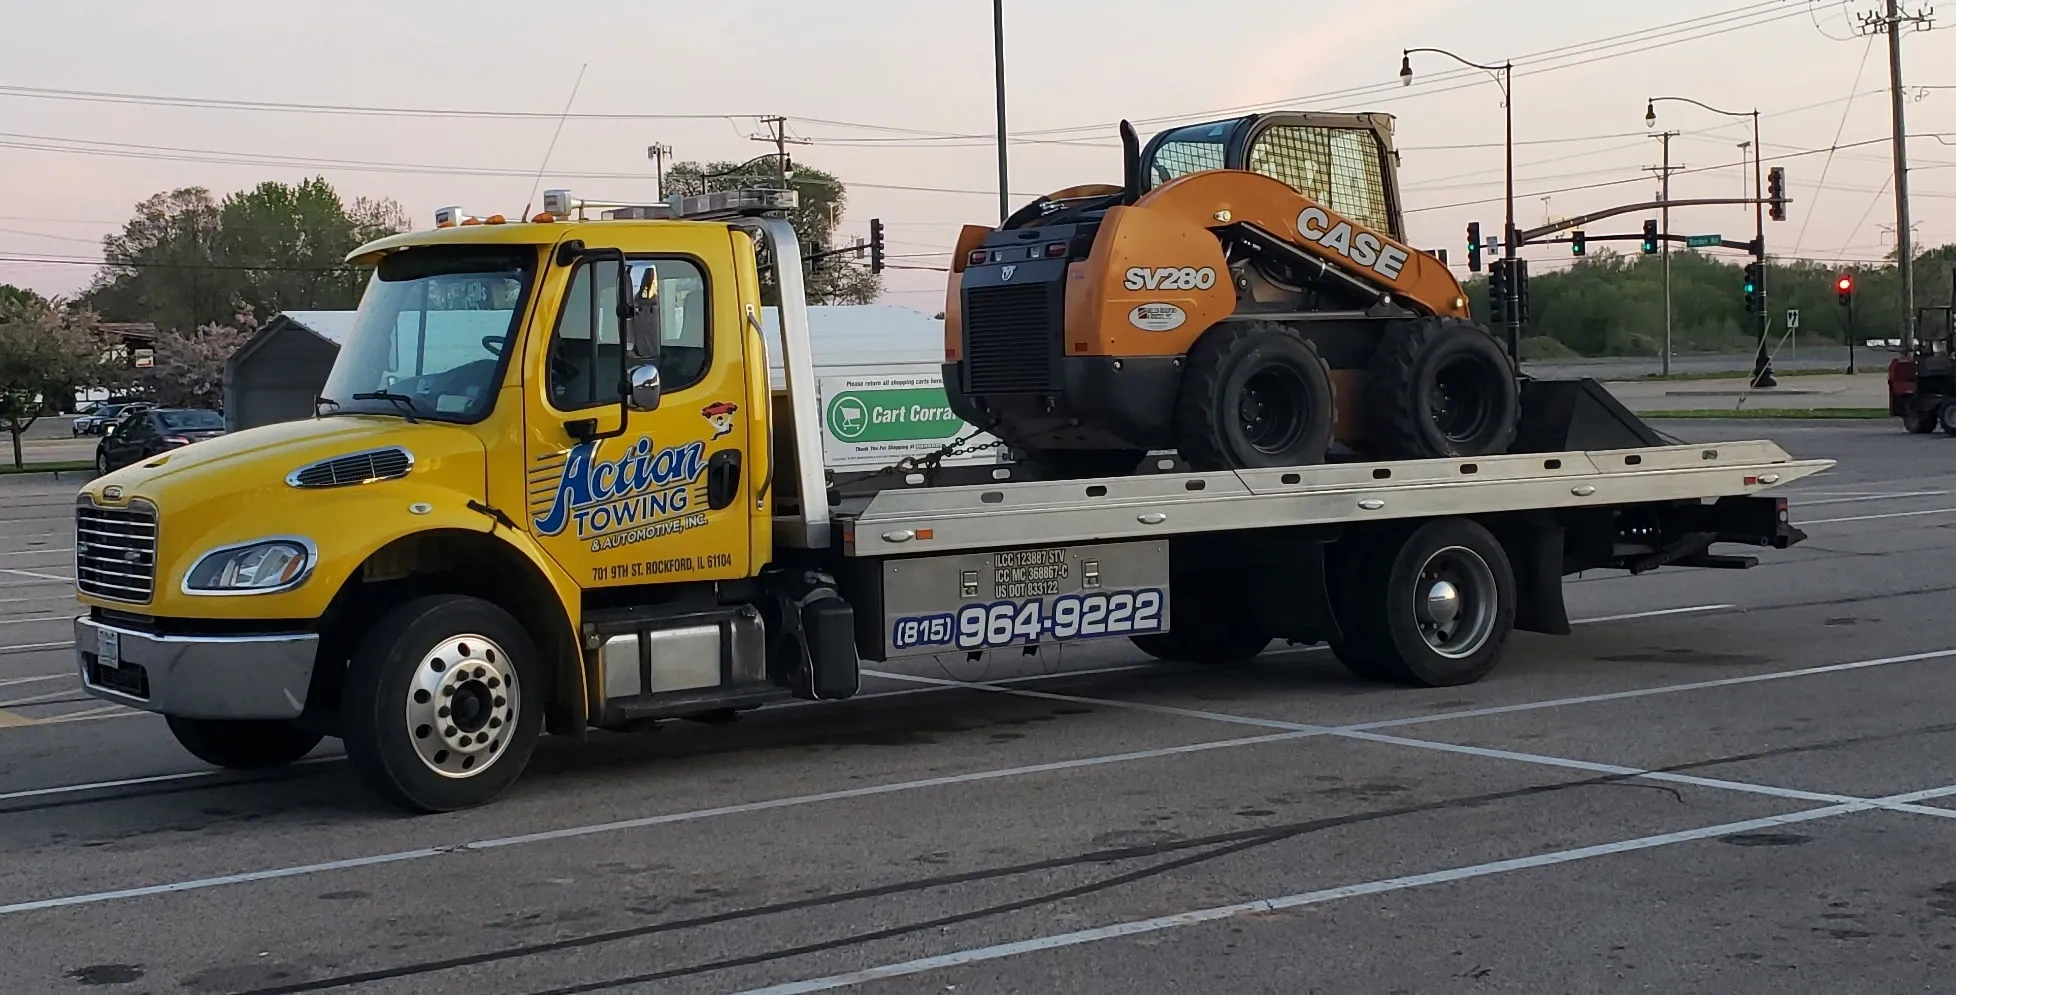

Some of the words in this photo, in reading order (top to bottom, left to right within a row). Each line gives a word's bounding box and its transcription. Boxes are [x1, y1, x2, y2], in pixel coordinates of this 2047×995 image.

[1296, 206, 1409, 281] CASE
[1124, 267, 1216, 291] SV280
[891, 379, 915, 387] shopping
[872, 405, 906, 424] Cart
[534, 436, 708, 535] Action
[574, 487, 687, 537] TOWING
[591, 539, 600, 551] &
[603, 520, 684, 549] AUTOMOTIVE,
[685, 513, 709, 530] INC.
[592, 567, 608, 581] 701
[611, 564, 629, 579] 9TH
[631, 562, 643, 577] ST.
[646, 557, 695, 576] ROCKFORD,
[697, 555, 705, 570] IL
[707, 553, 731, 568] 61104
[995, 552, 1014, 567] ILCC
[1016, 550, 1047, 566] 123887
[1048, 549, 1065, 564] STV
[995, 568, 1010, 583] ICC
[1012, 567, 1026, 582] MC
[1028, 564, 1068, 580] 368867-C
[995, 584, 1007, 599] US
[1008, 583, 1026, 597] DOT
[1027, 580, 1058, 596] 833122
[896, 617, 951, 646] (815)
[957, 592, 1160, 647] 964-9222
